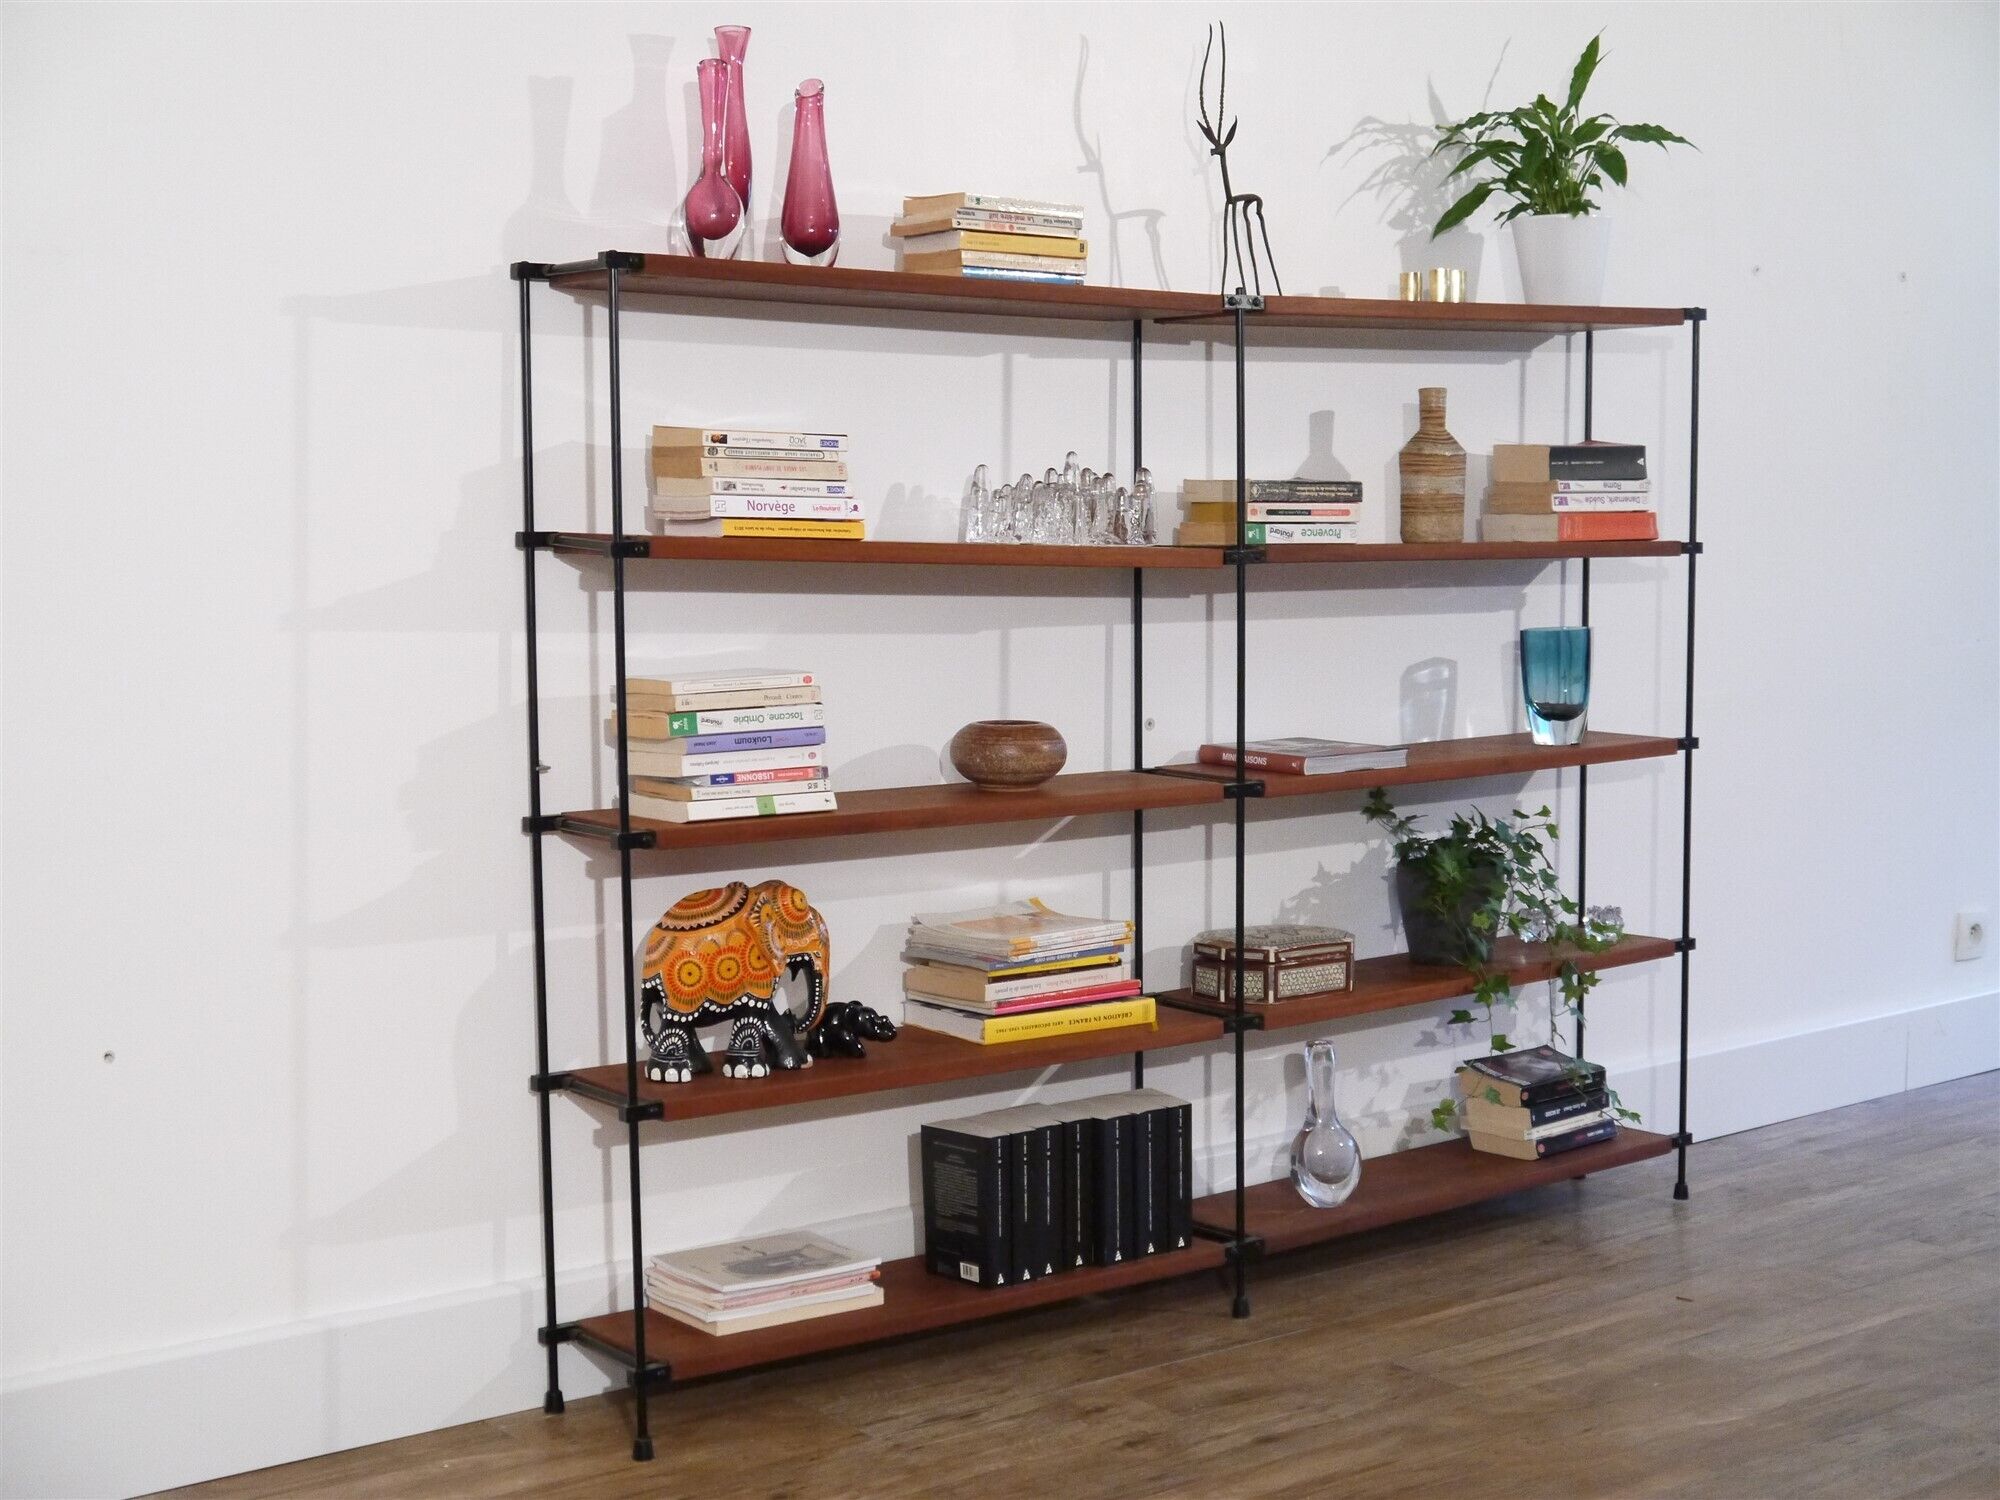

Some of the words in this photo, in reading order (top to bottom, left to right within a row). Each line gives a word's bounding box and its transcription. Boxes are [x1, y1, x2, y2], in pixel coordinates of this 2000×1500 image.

[1603, 482, 1622, 490] Rome
[747, 499, 796, 515] Norvège
[1301, 528, 1342, 539] Provence
[733, 713, 764, 723] Ombrie
[768, 711, 804, 721] Toscane,
[734, 736, 772, 744] Loukoum
[737, 772, 774, 782] LISBONNE
[1068, 1016, 1092, 1026] FRANCE
[1103, 1011, 1133, 1021] CRÉATION
